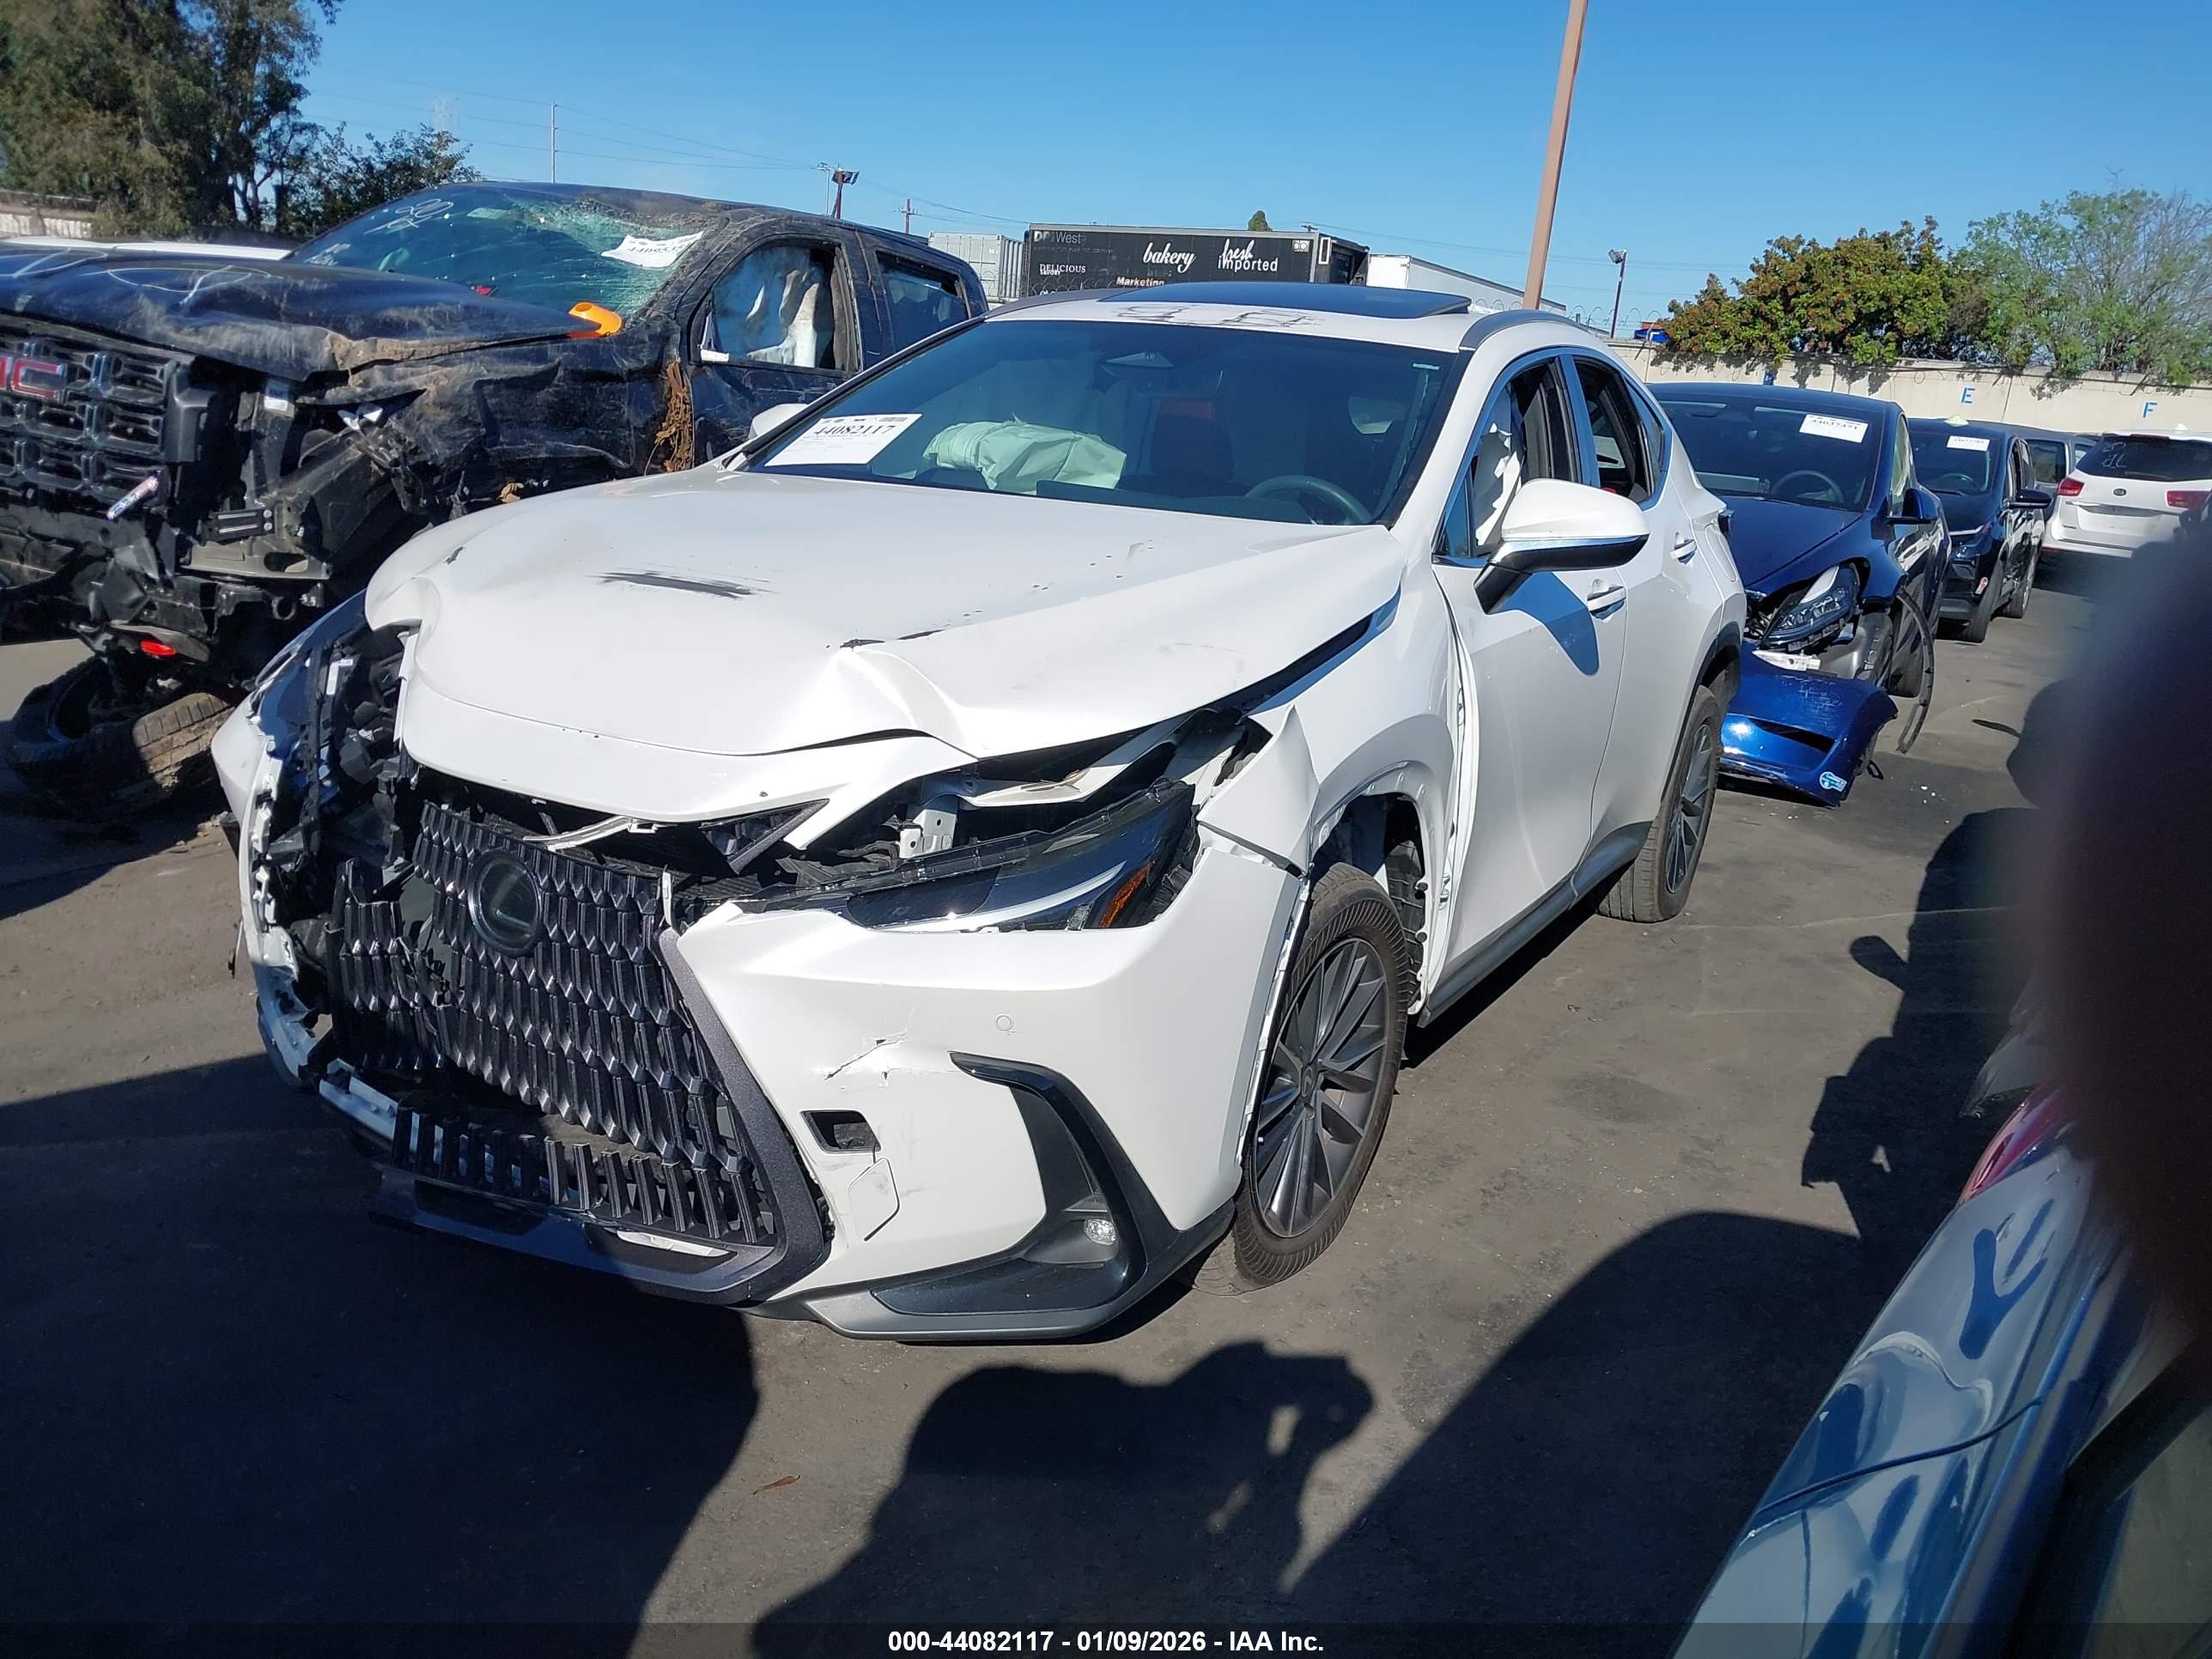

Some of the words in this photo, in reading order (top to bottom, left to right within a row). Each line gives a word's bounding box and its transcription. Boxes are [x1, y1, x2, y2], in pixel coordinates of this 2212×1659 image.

[1055, 231, 1081, 244] West
[1143, 242, 1197, 274] bakery
[1222, 238, 1255, 264] fresh
[1040, 264, 1085, 273] DELICIOUS
[1218, 255, 1279, 272] imported
[1961, 386, 1976, 404] E
[2142, 401, 2158, 418] F
[813, 424, 896, 434] 44082117
